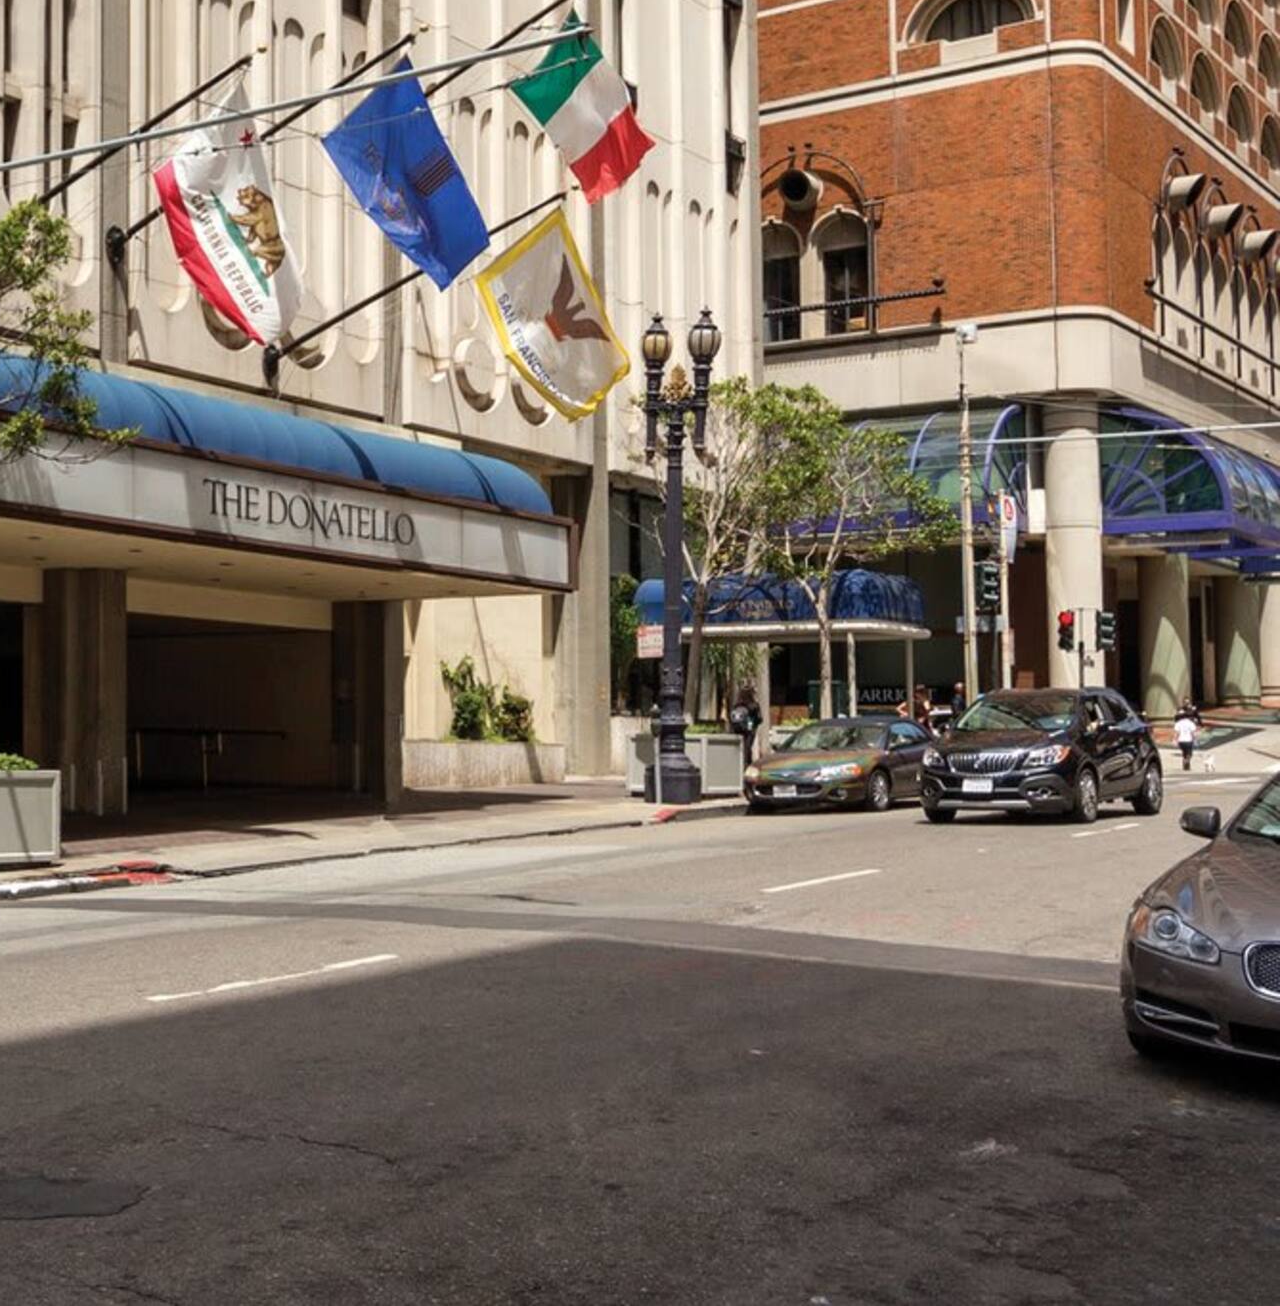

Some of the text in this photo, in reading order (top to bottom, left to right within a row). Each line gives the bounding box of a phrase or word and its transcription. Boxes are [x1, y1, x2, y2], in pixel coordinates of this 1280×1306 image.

[224, 261, 264, 314] REPUBLIC
[498, 293, 519, 325] SAN
[202, 478, 415, 546] THE DONATELLO
